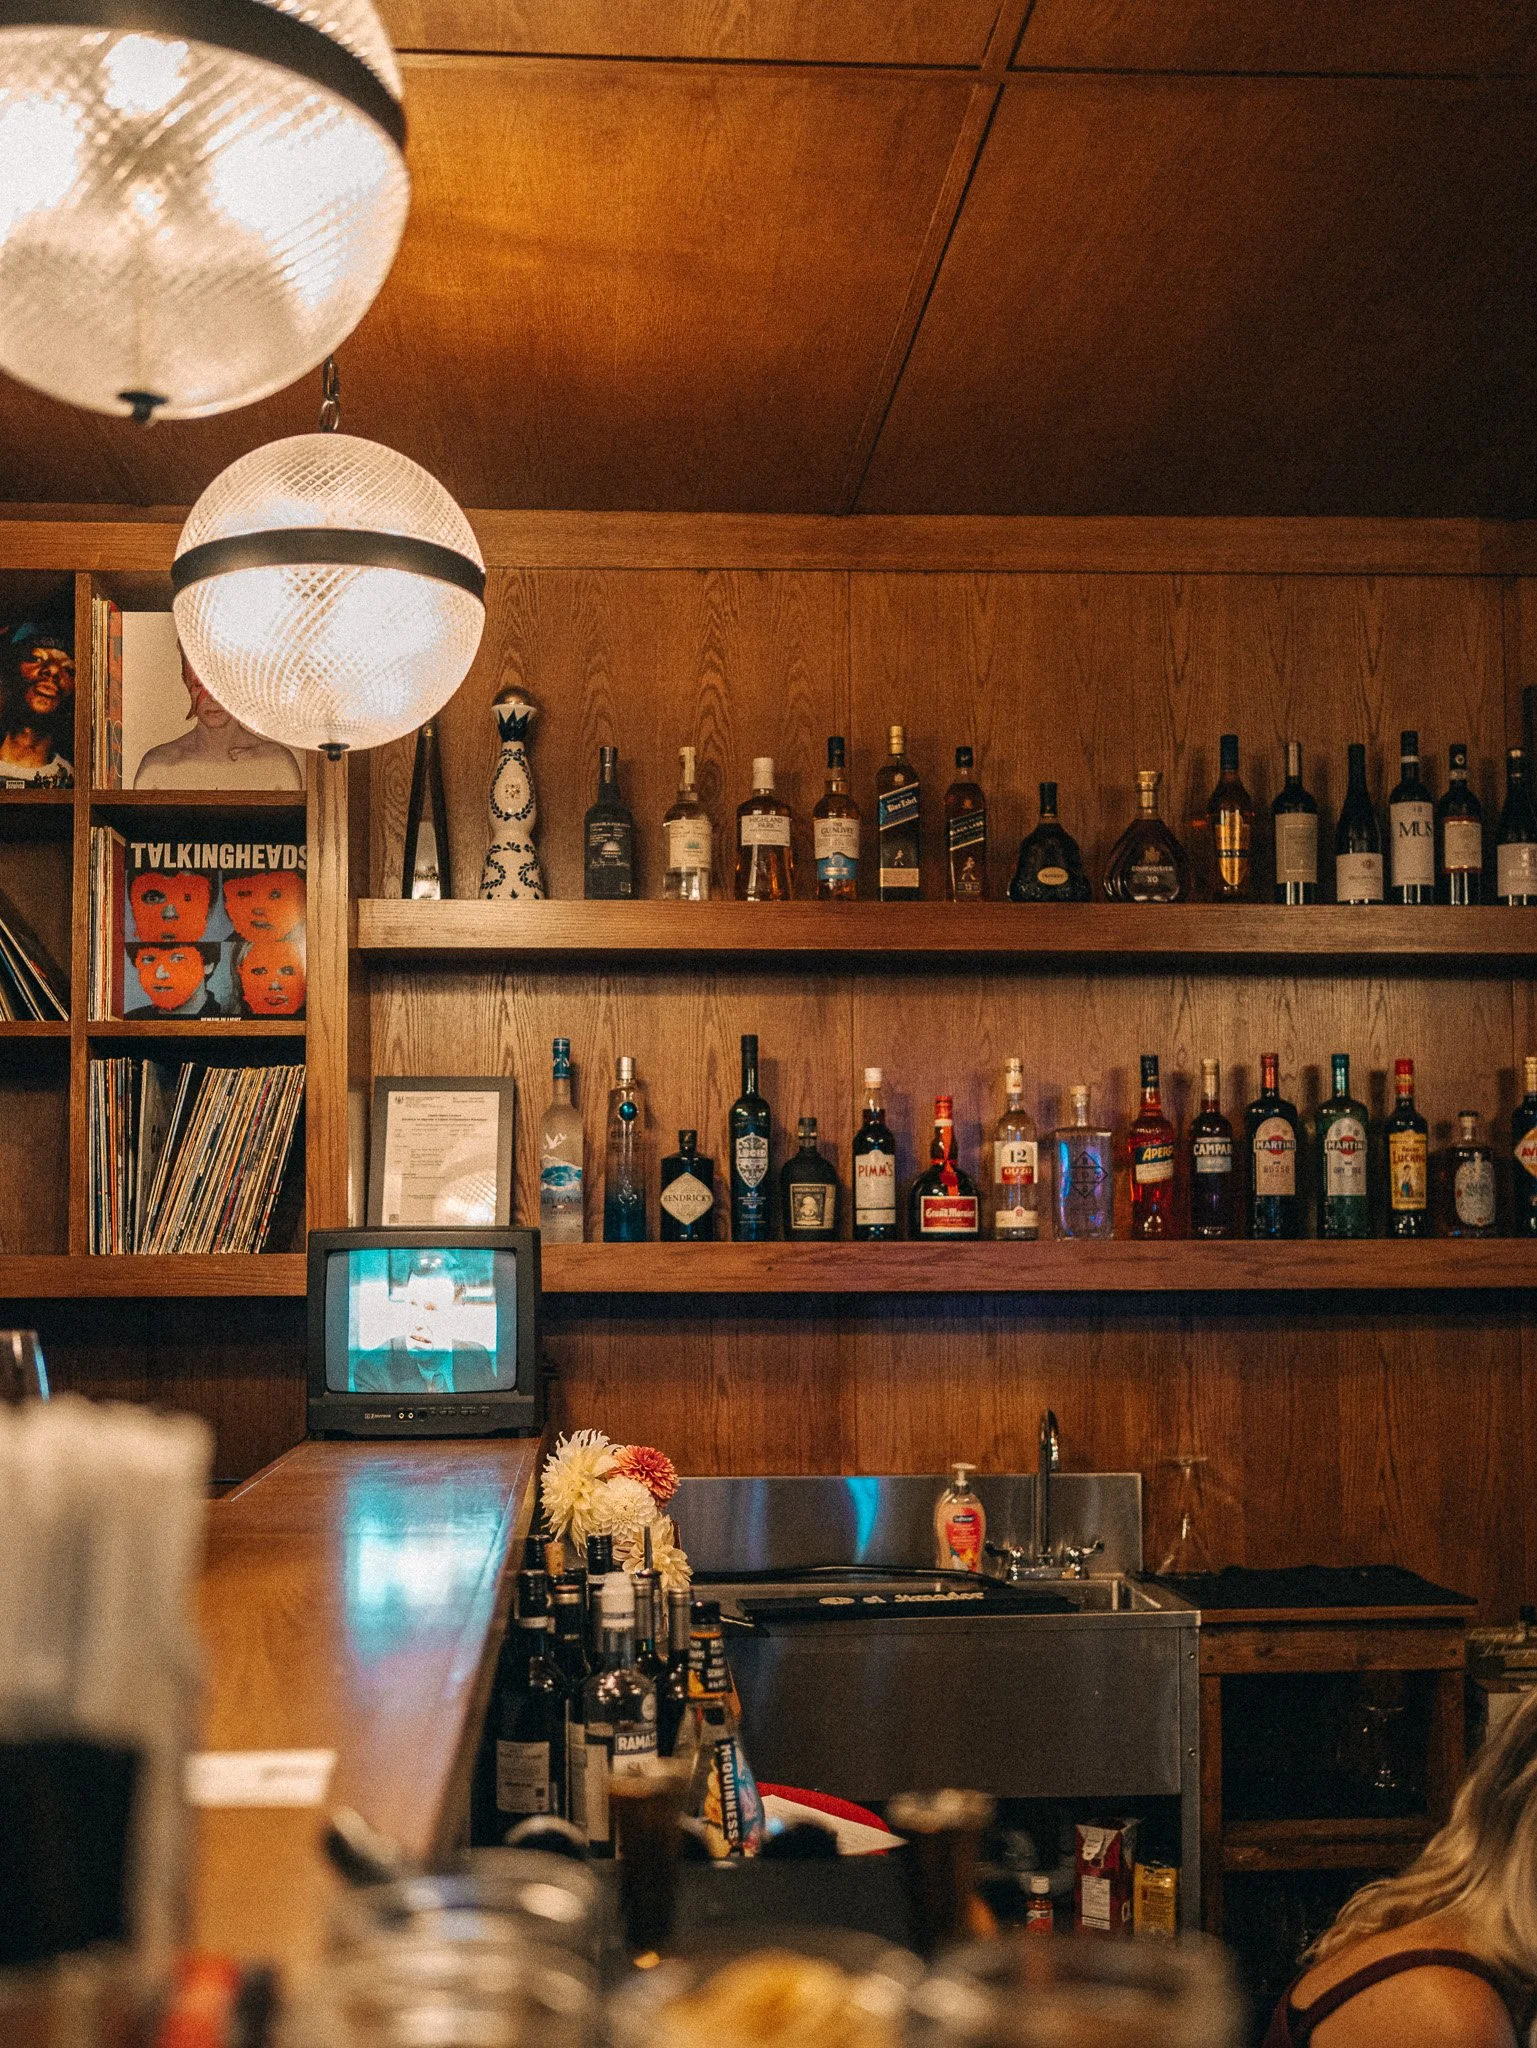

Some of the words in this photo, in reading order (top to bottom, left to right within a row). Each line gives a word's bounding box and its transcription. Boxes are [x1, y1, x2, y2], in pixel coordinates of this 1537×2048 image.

[130, 843, 307, 869] TALKINGHEADS
[1147, 875, 1159, 883] XO
[1010, 1149, 1027, 1163] 12
[858, 1161, 894, 1177] PIMM'S
